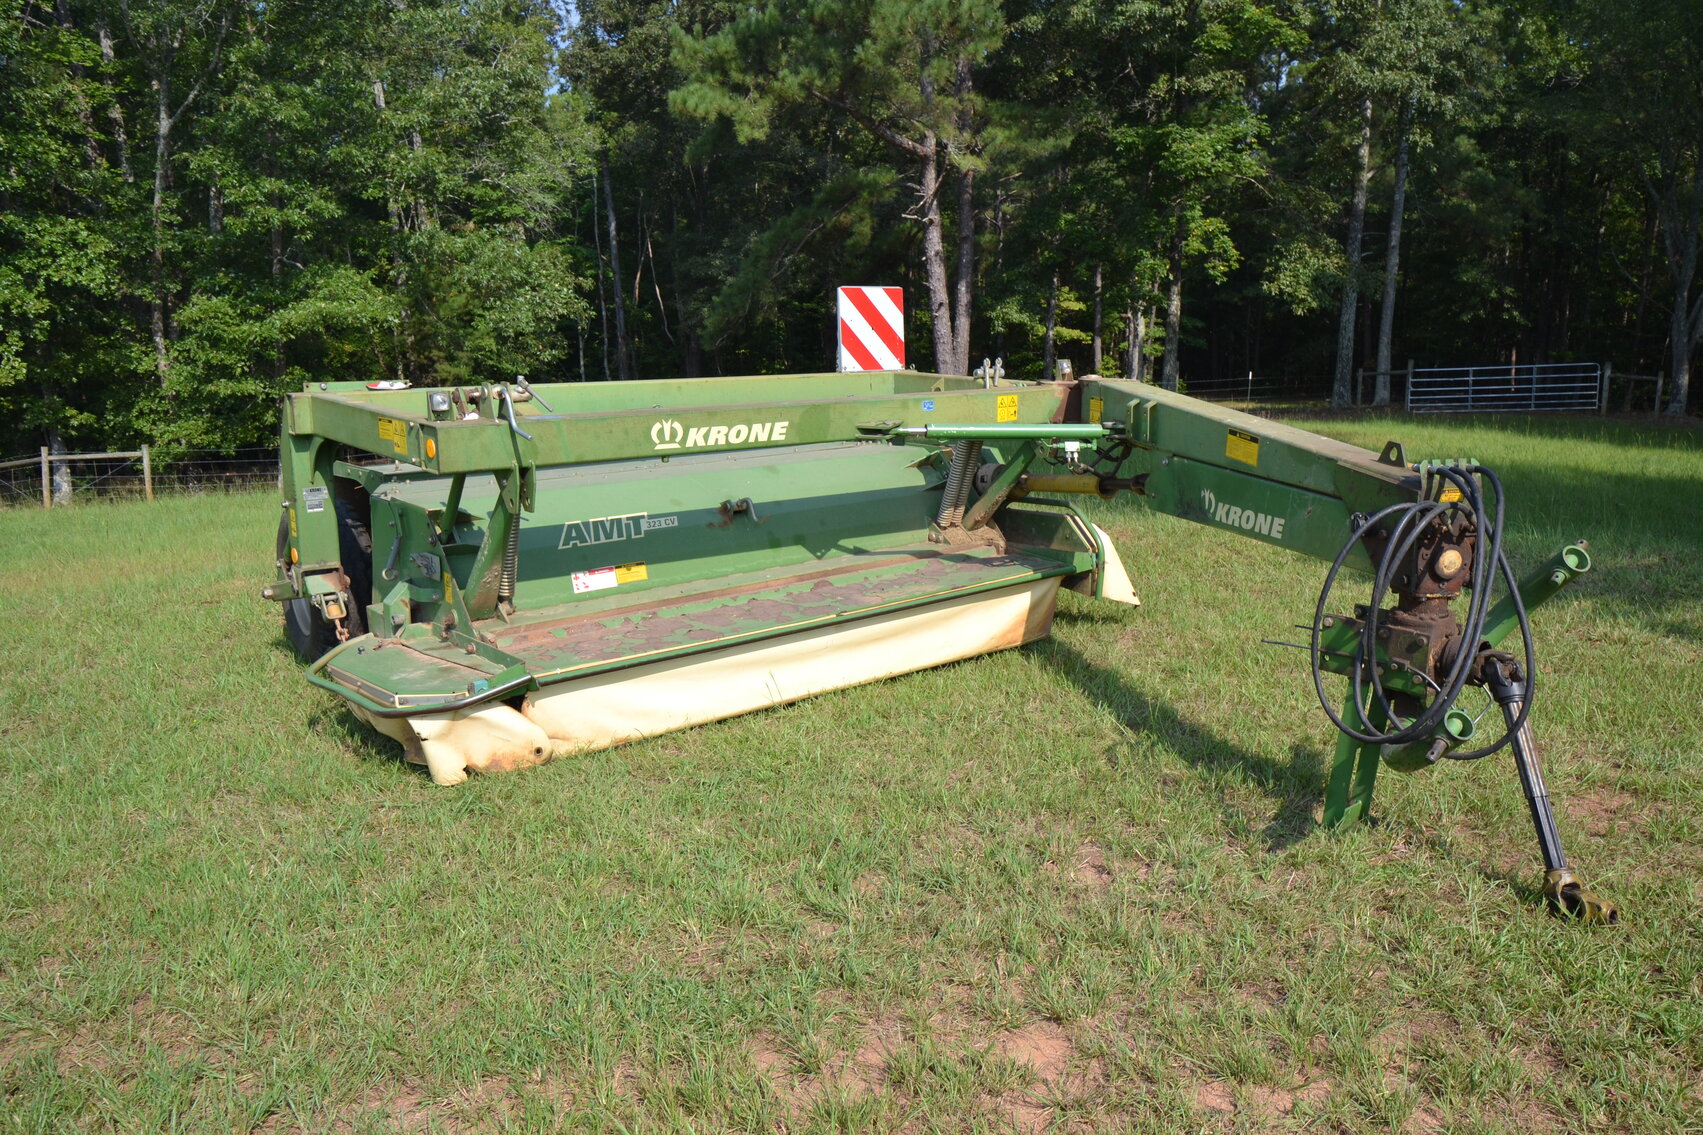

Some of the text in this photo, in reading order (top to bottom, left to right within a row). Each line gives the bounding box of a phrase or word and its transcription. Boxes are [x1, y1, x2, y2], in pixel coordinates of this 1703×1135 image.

[685, 421, 789, 448] KRONE
[558, 512, 676, 550] AMT 323 CV
[1215, 502, 1286, 539] KRONE
